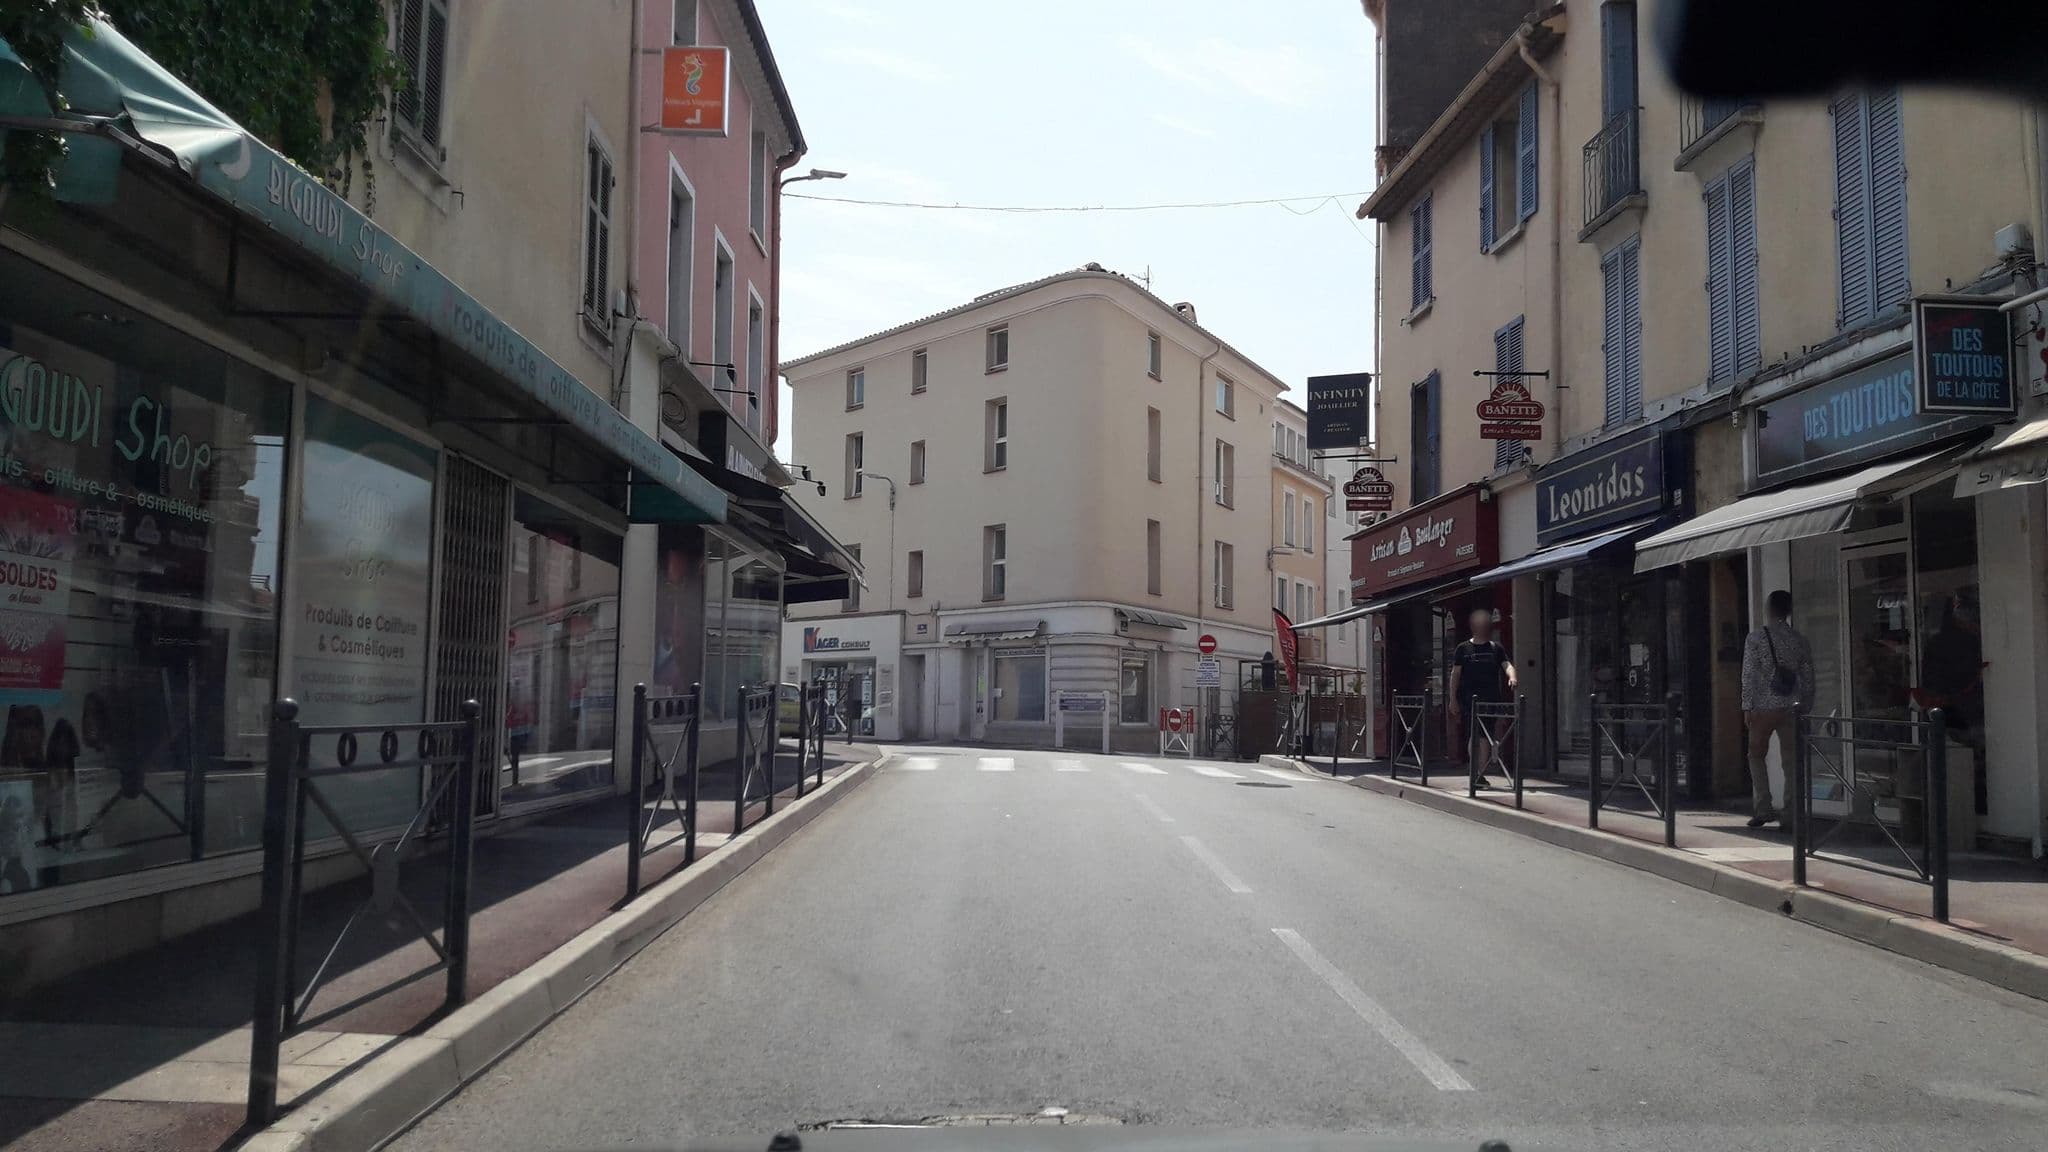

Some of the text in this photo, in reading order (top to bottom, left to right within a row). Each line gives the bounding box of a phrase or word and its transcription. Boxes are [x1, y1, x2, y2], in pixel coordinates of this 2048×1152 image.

[266, 159, 404, 286] BIGOUDI Shop
[1951, 327, 1982, 351] DES
[1932, 353, 2004, 377] TOUTOUS
[1309, 387, 1365, 401] INFINITY
[1803, 368, 1913, 441] DES TOUTOUS
[1937, 382, 1952, 398] DE
[1954, 382, 1970, 399] LA
[1485, 405, 1538, 415] BANETTE
[114, 396, 212, 489] Shop
[1349, 485, 1389, 493] BANETTE
[1548, 460, 1646, 522] Leonidas
[1415, 516, 1454, 548] Boulanger
[0, 561, 57, 591] SOLDES
[305, 602, 353, 628] Produits
[357, 613, 371, 631] de
